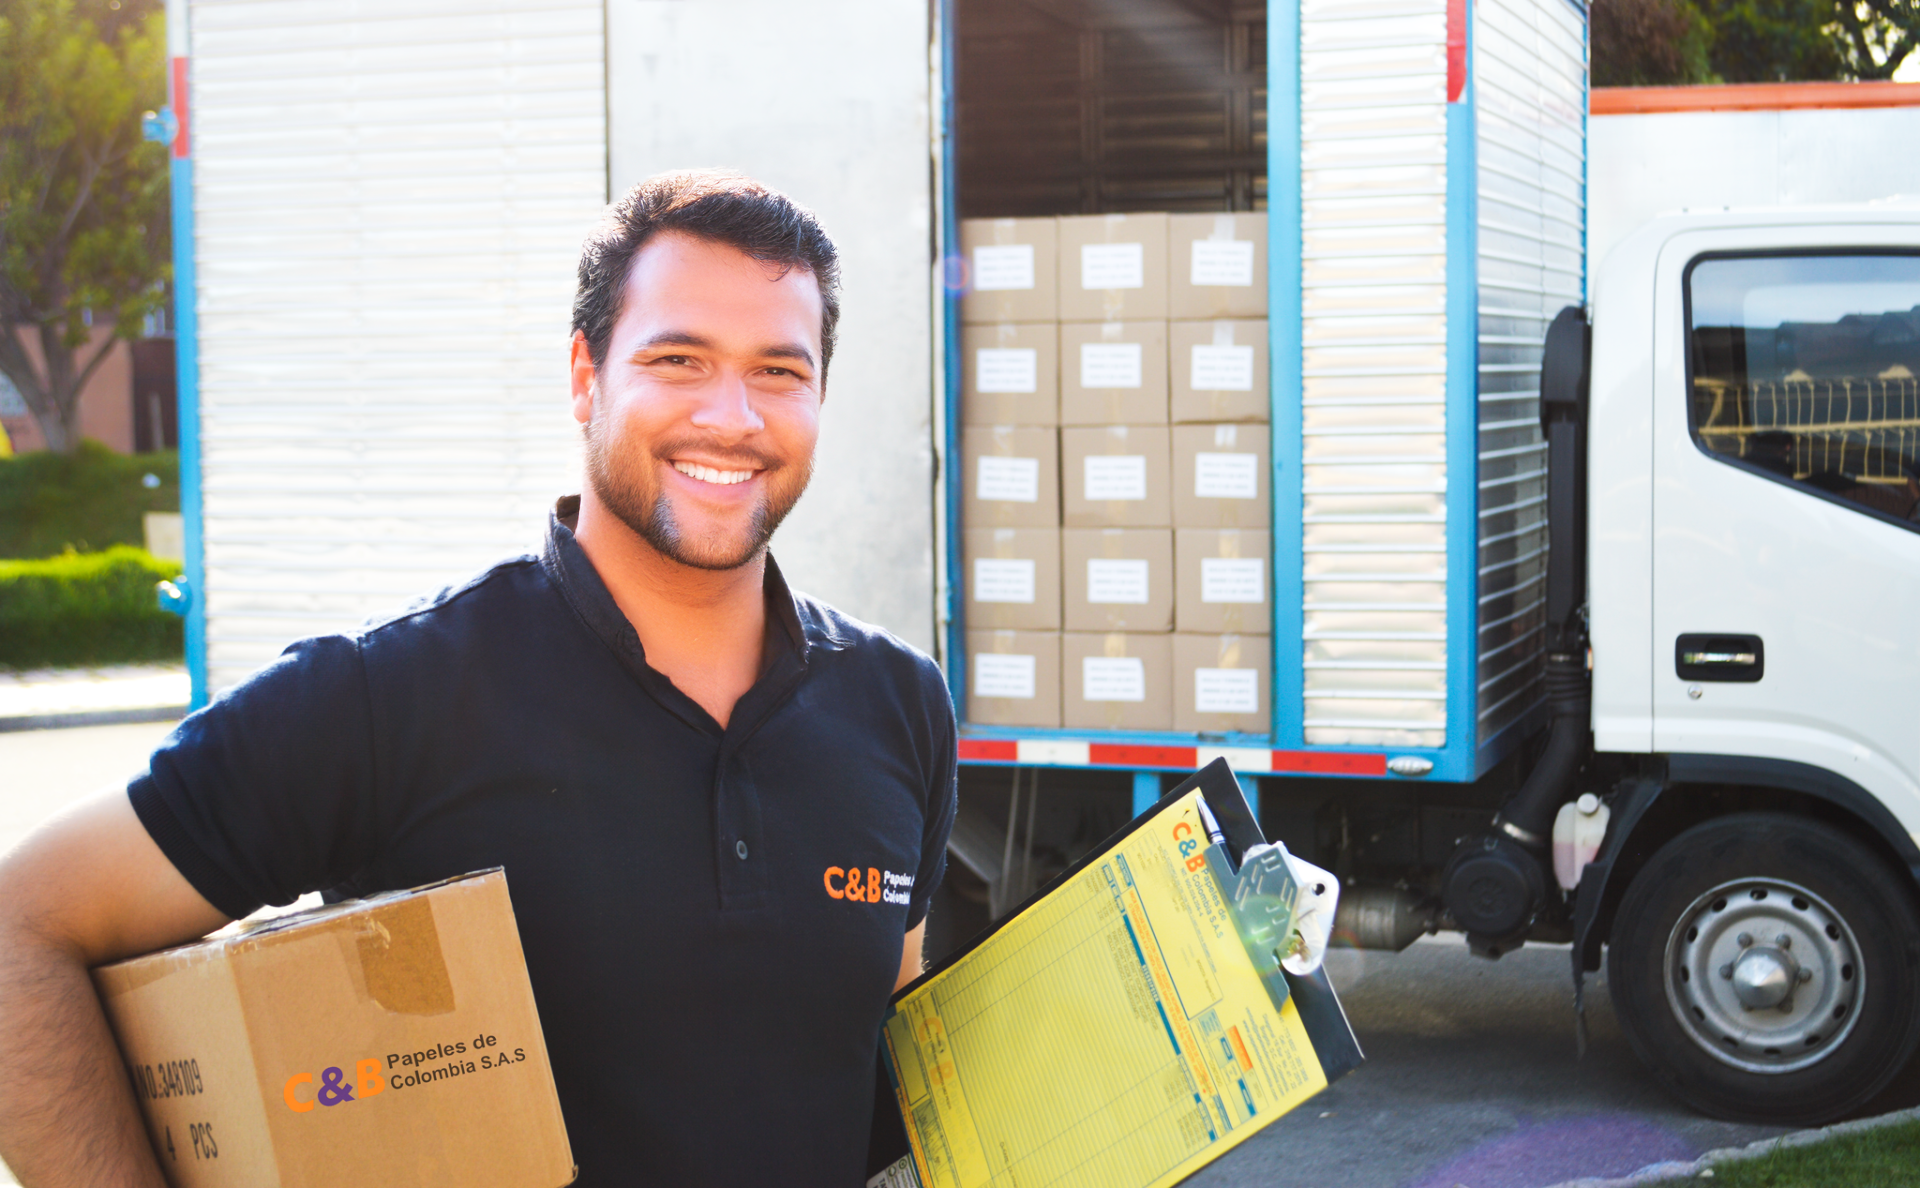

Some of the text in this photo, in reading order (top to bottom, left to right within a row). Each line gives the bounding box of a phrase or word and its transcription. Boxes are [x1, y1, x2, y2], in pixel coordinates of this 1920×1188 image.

[1172, 821, 1206, 873] C&B
[823, 865, 882, 903] C&B
[1191, 873, 1212, 916] Colombia
[1209, 915, 1225, 939] S.A.S
[1202, 868, 1227, 921] Papeles de
[386, 1033, 498, 1069] Papeles de
[390, 1047, 526, 1090] Colombia S.A.S
[283, 1057, 386, 1113] C&B
[165, 1122, 218, 1161] 4 PCS
